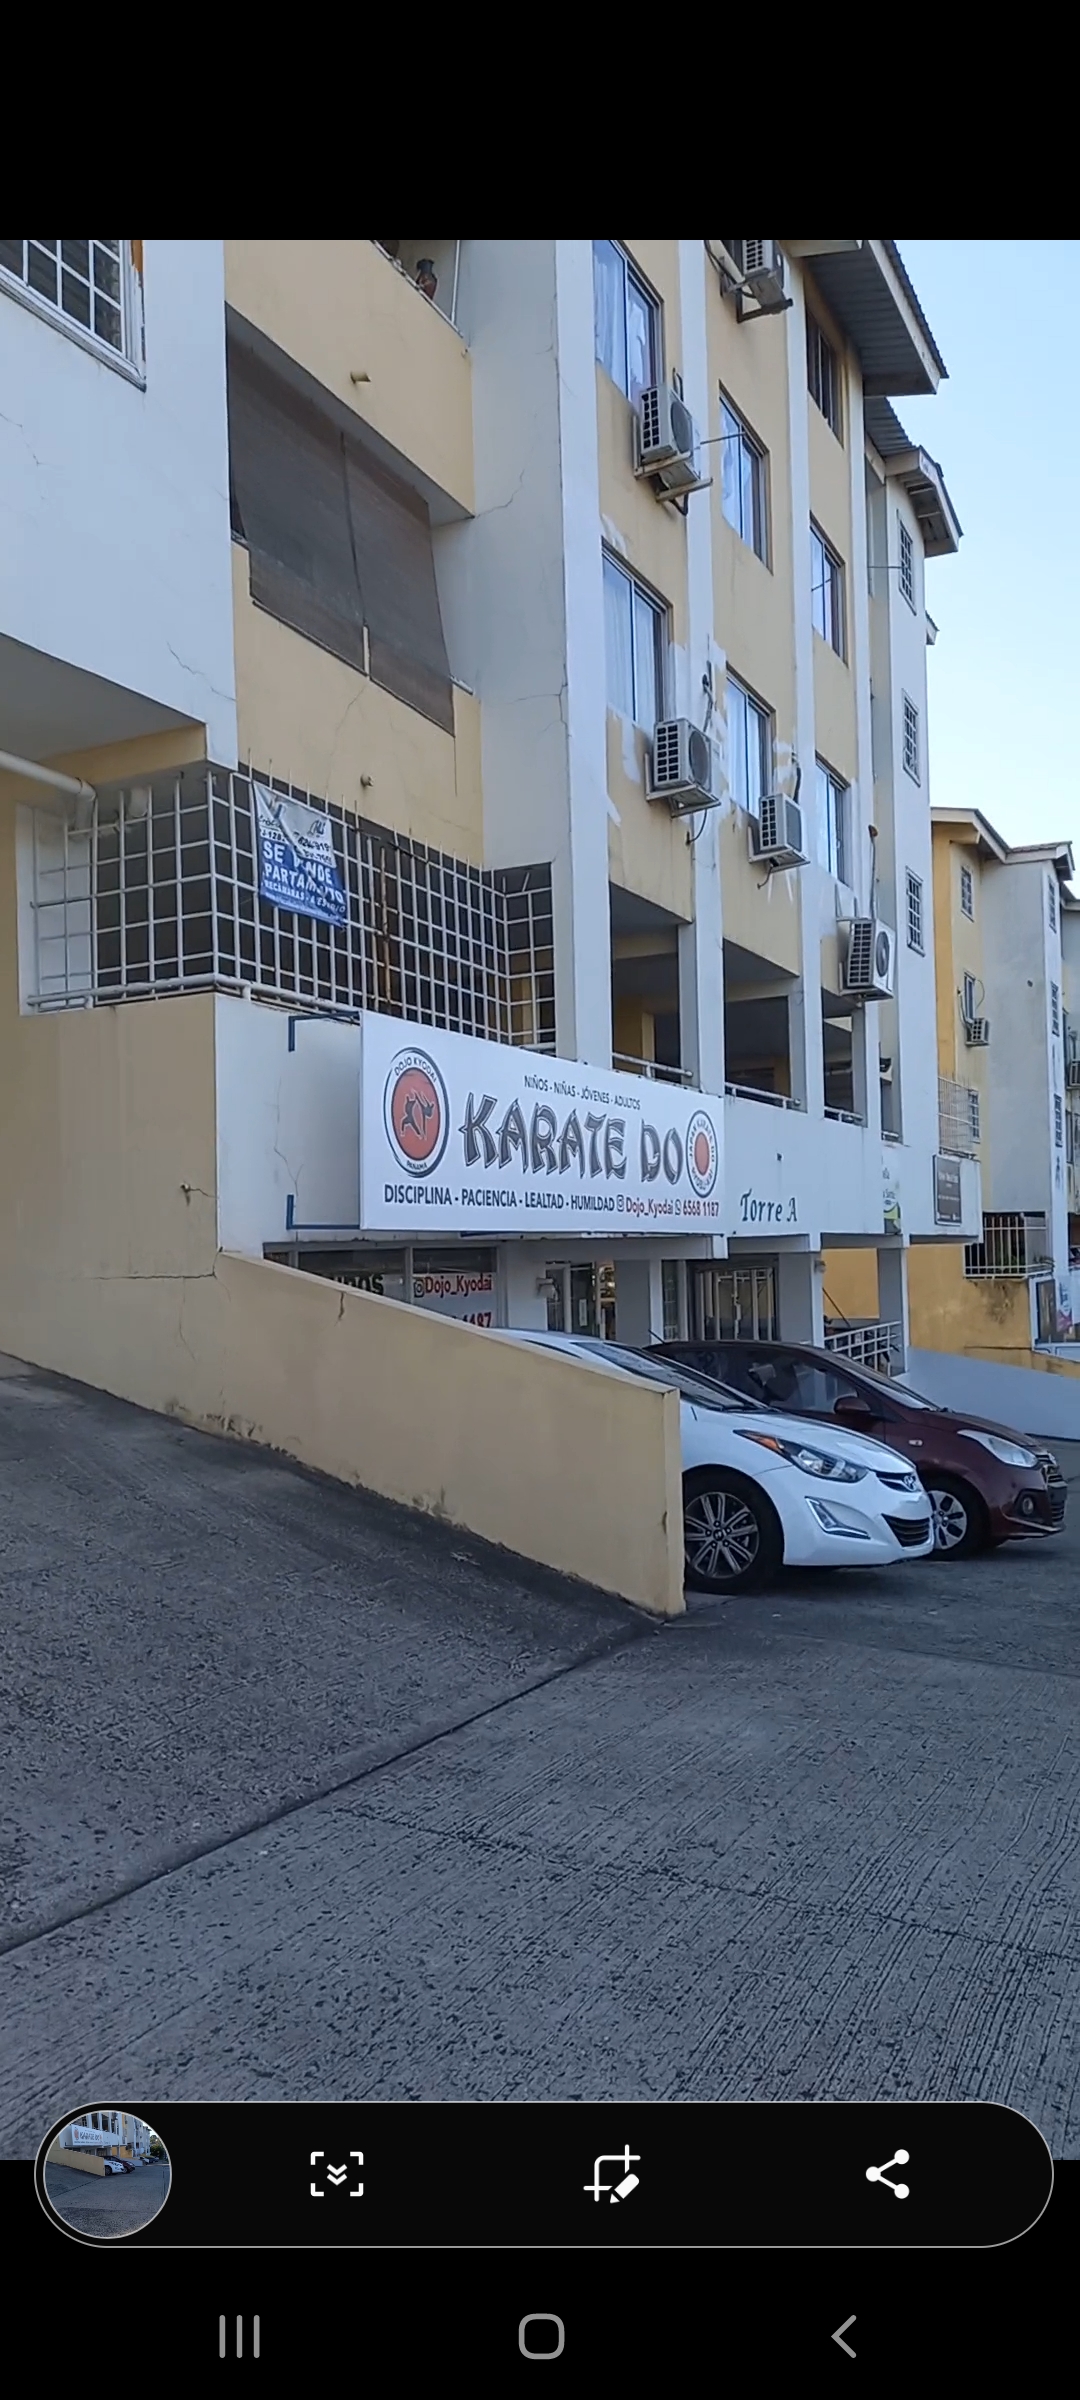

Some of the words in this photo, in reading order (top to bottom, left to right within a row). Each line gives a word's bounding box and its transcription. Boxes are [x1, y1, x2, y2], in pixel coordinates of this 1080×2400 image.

[263, 841, 286, 864] SE
[292, 851, 333, 886] VNDE
[394, 1056, 412, 1077] DOJO
[413, 1056, 437, 1083] KYODAI
[524, 1074, 548, 1092] NIÑOS
[554, 1080, 576, 1097] NIÑAS
[581, 1085, 610, 1104] JÓVENES
[614, 1095, 641, 1111] ADULTOS
[458, 1092, 628, 1180] KARATE
[640, 1118, 684, 1186] DO
[384, 1184, 452, 1205] DISCIPLINA
[461, 1188, 517, 1207] PACIENCIA
[525, 1191, 564, 1209] LEALTAD
[571, 1194, 615, 1211] HUMILDAD
[626, 1197, 673, 1218] Dojo_Kyodai
[740, 1188, 783, 1222] Torre
[786, 1197, 797, 1222] A
[425, 1275, 492, 1298] Dojo_Kyodai
